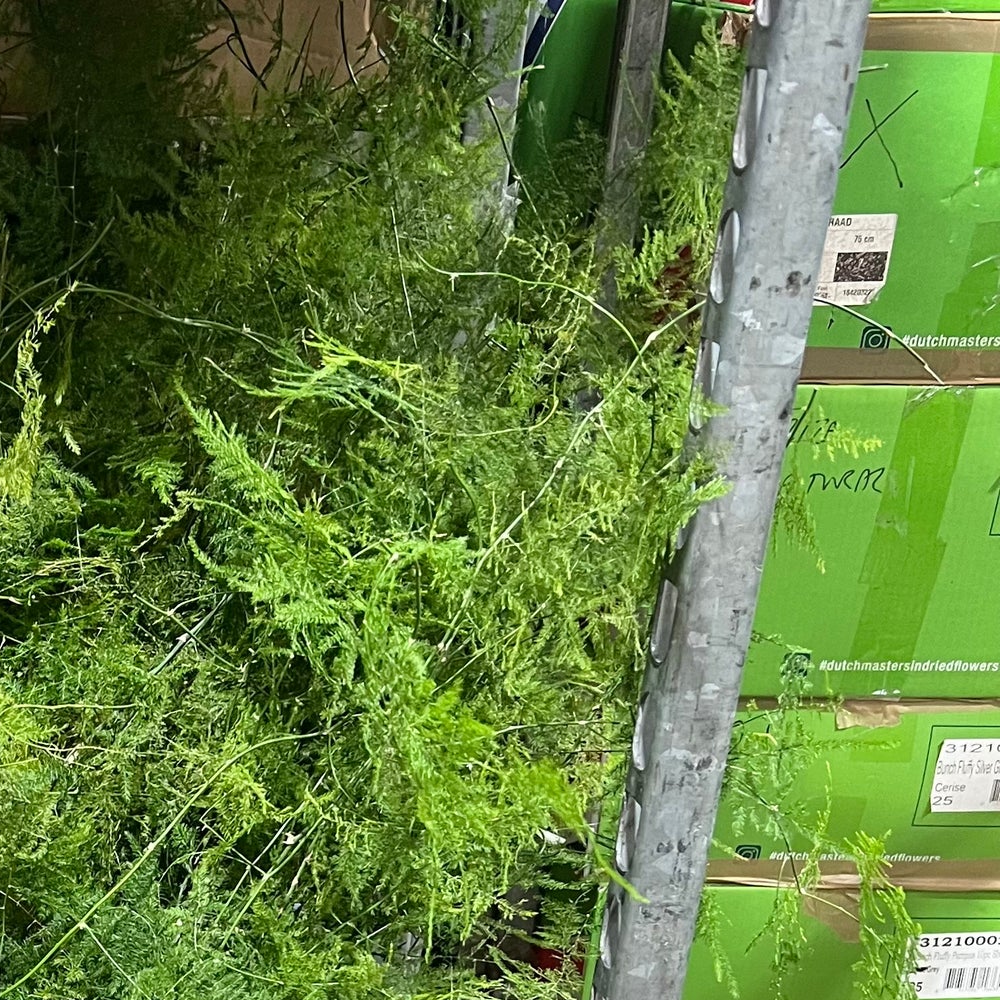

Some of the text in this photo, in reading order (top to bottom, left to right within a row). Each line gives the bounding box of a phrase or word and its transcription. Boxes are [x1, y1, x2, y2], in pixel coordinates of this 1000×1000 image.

[854, 234, 863, 243] 75
[902, 333, 1000, 348] #dutchmasters
[819, 659, 999, 673] #dutchmastersindriedflowers
[934, 782, 966, 793] Cerise
[932, 795, 953, 806] 25
[920, 935, 1000, 948] 3121000
